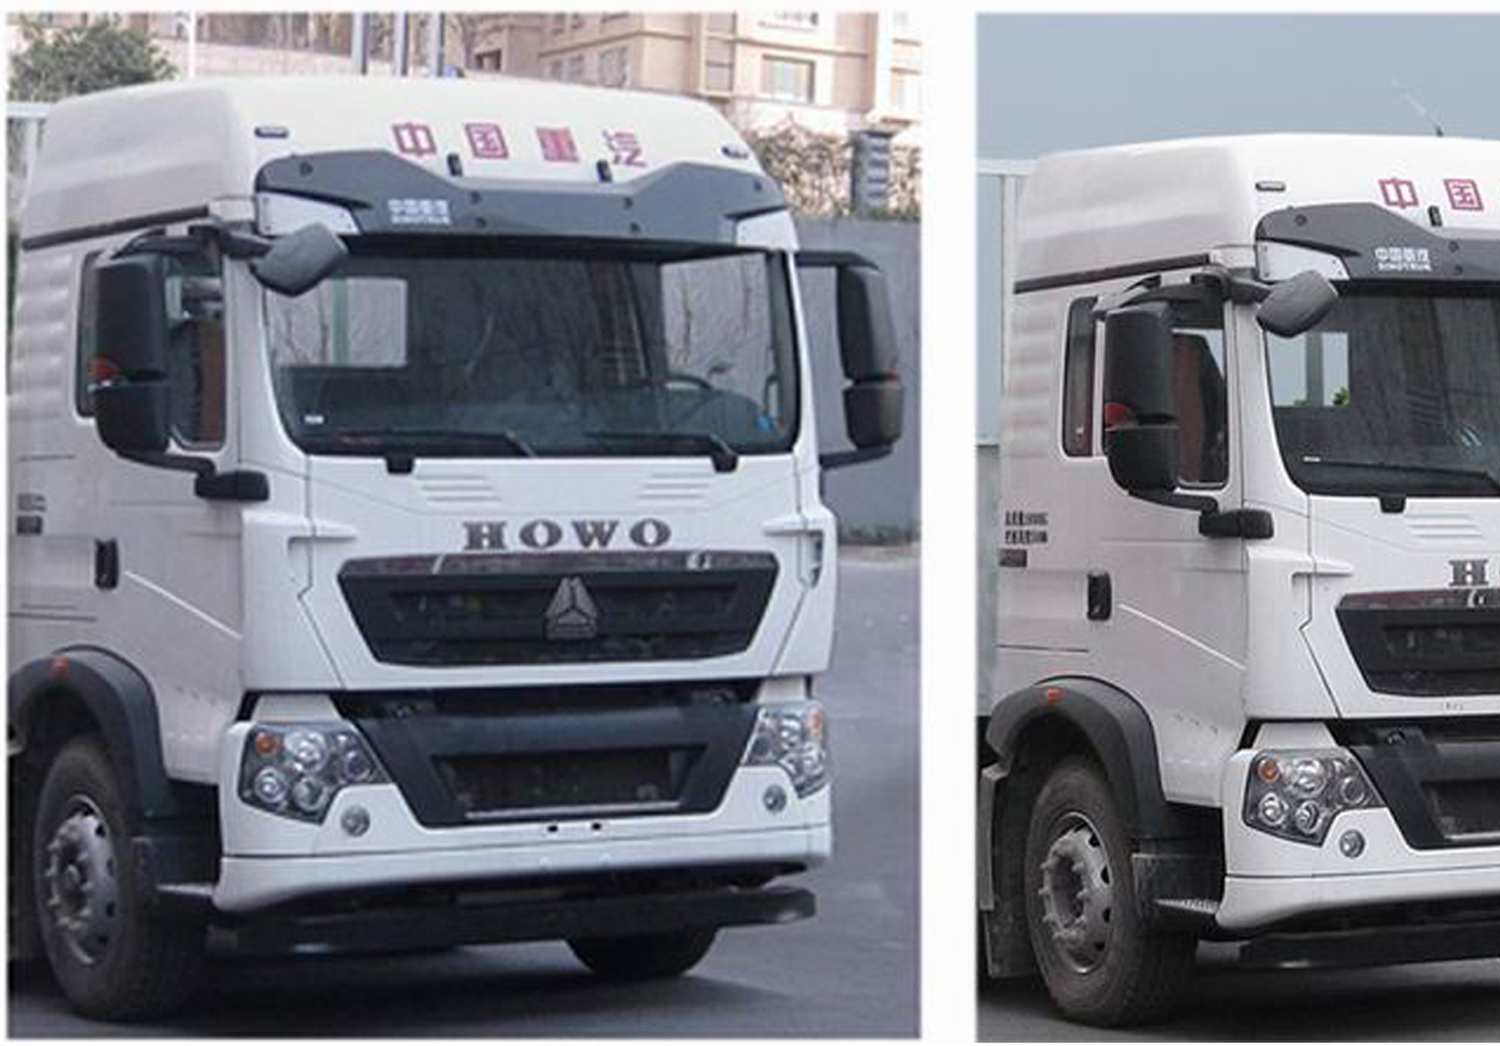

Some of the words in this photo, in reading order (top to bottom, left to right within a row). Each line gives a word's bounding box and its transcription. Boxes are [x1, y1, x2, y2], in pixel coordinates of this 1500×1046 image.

[391, 122, 648, 168] 中国重汽
[462, 518, 672, 550] HOWO
